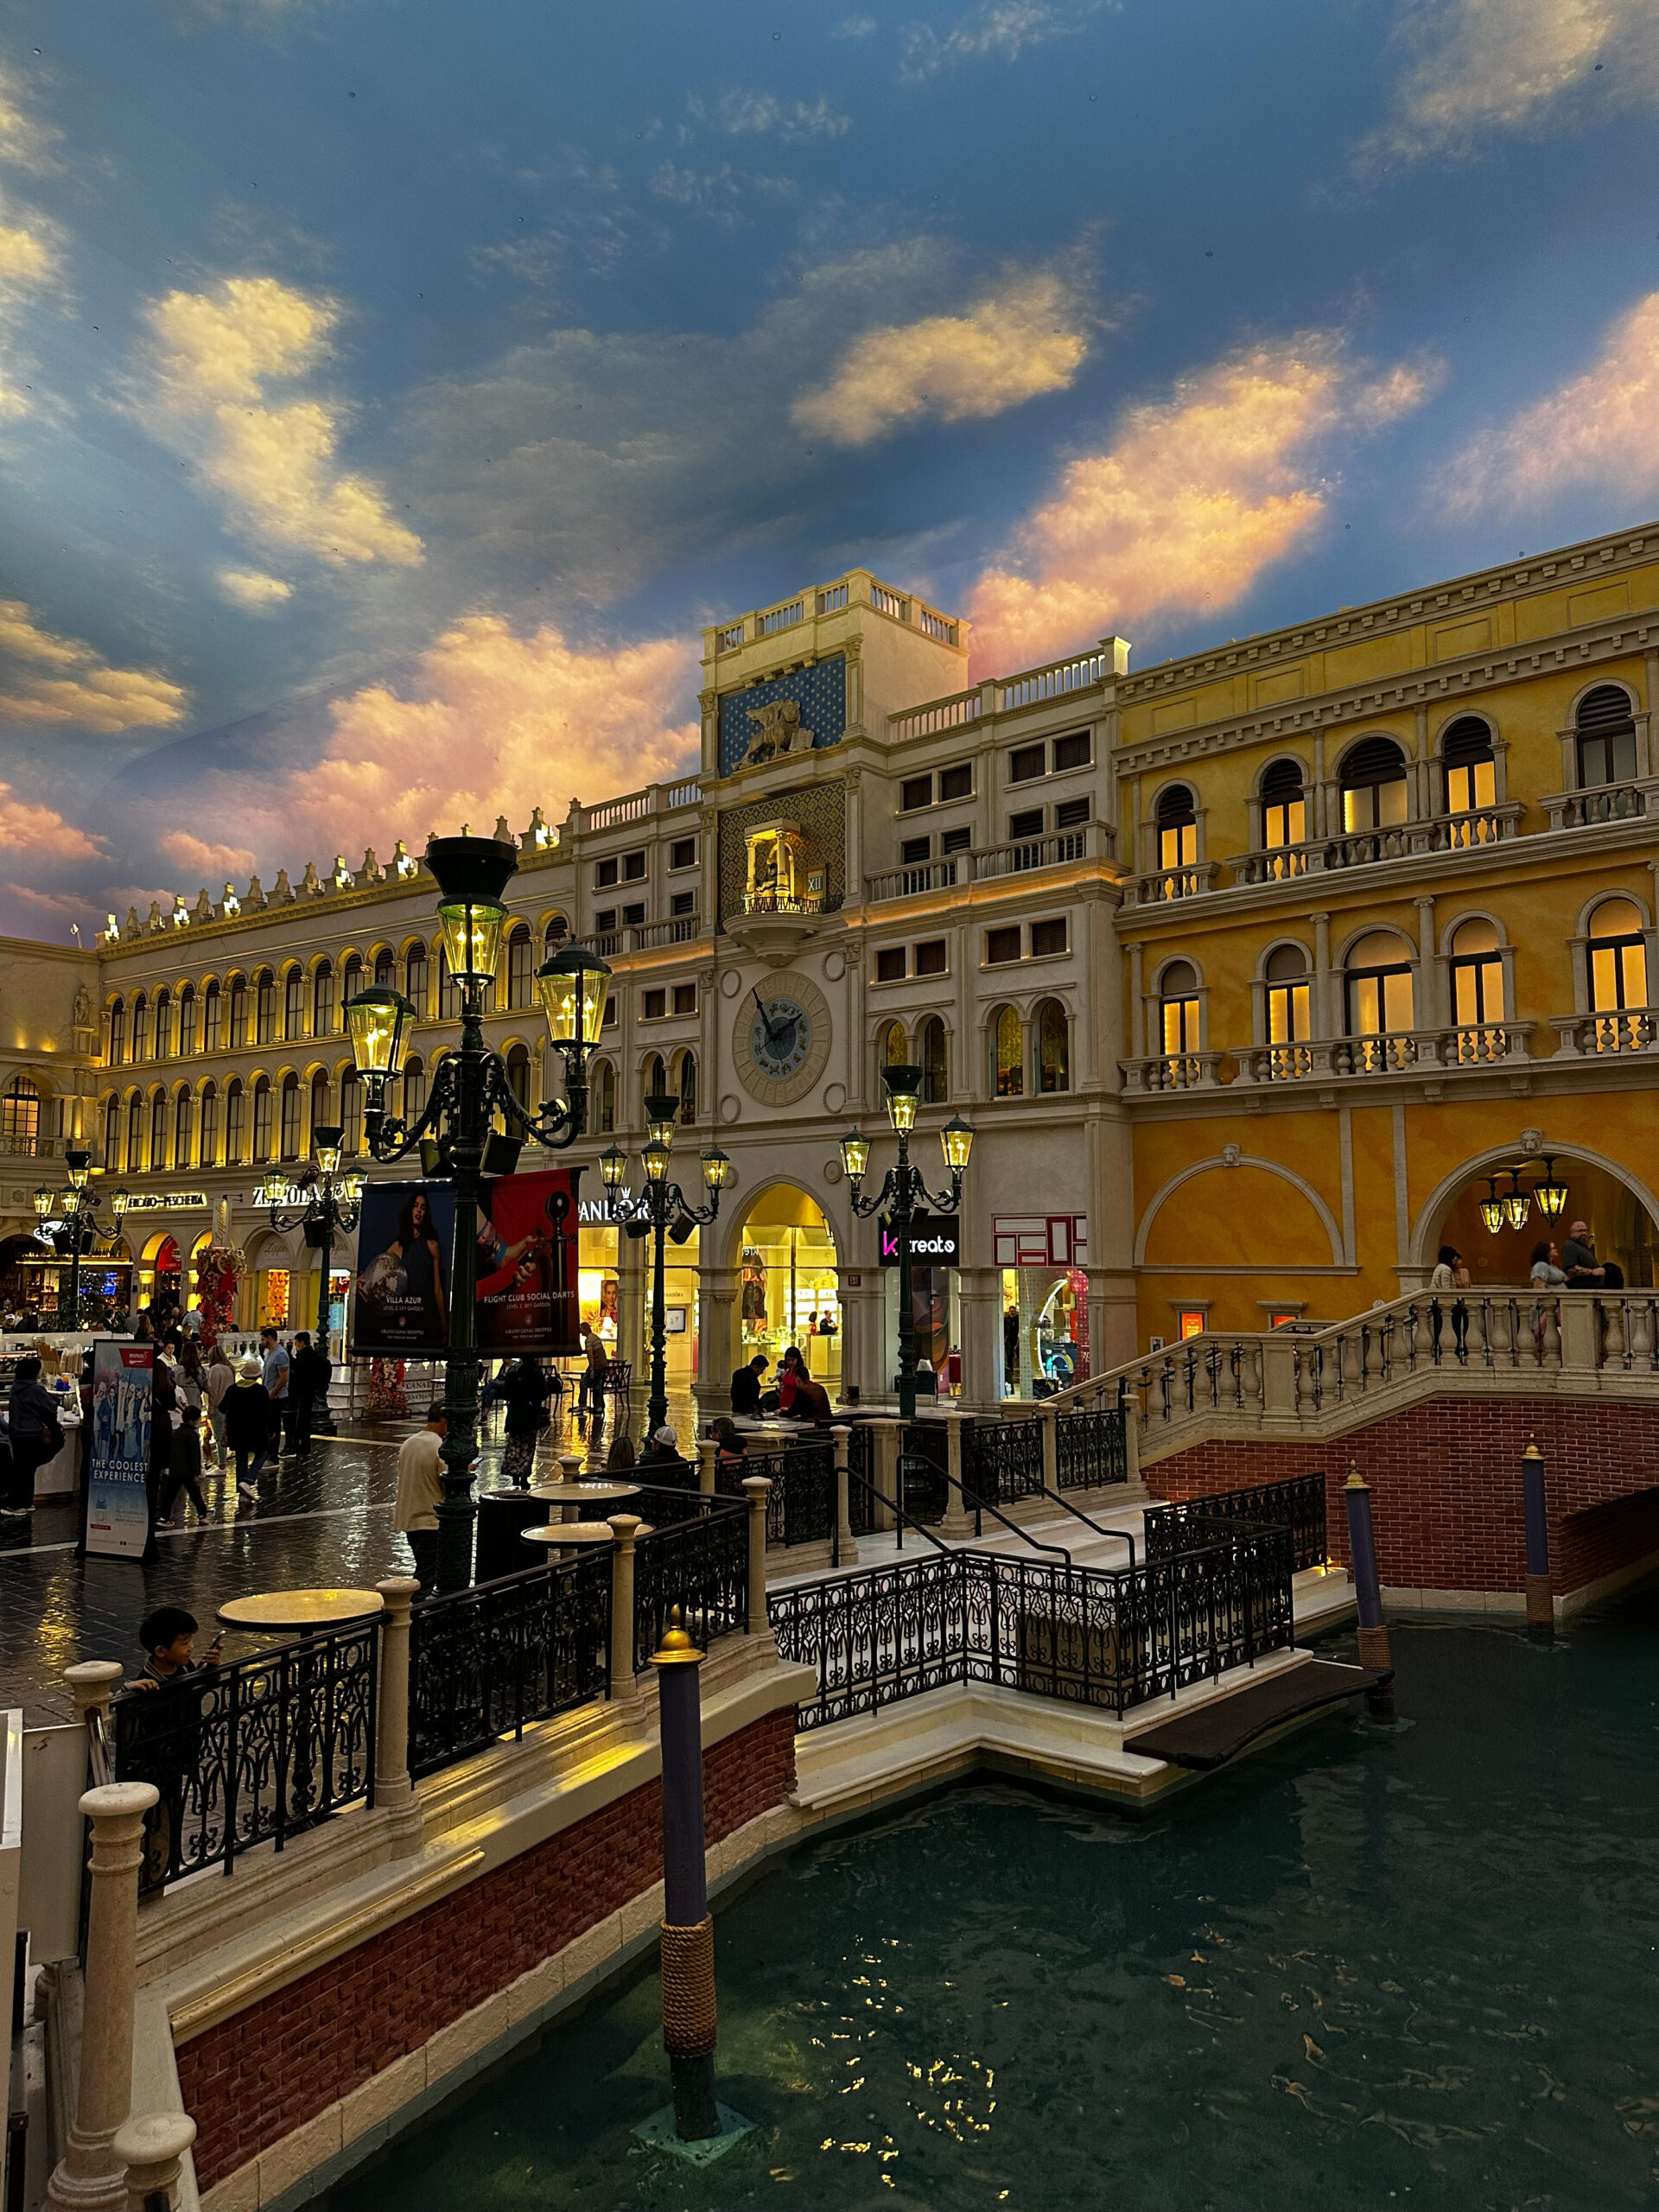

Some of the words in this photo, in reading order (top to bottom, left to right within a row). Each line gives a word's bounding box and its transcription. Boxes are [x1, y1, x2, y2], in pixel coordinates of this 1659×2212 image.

[808, 876, 822, 892] XII
[909, 1235, 955, 1253] reats
[386, 1295, 404, 1304] VILLA
[508, 1294, 524, 1302] CLUB
[527, 1292, 550, 1300] SOCIAL
[92, 1459, 106, 1468] THE
[109, 1460, 148, 1471] COOLEST
[93, 1470, 145, 1483] EXPERIENCE
